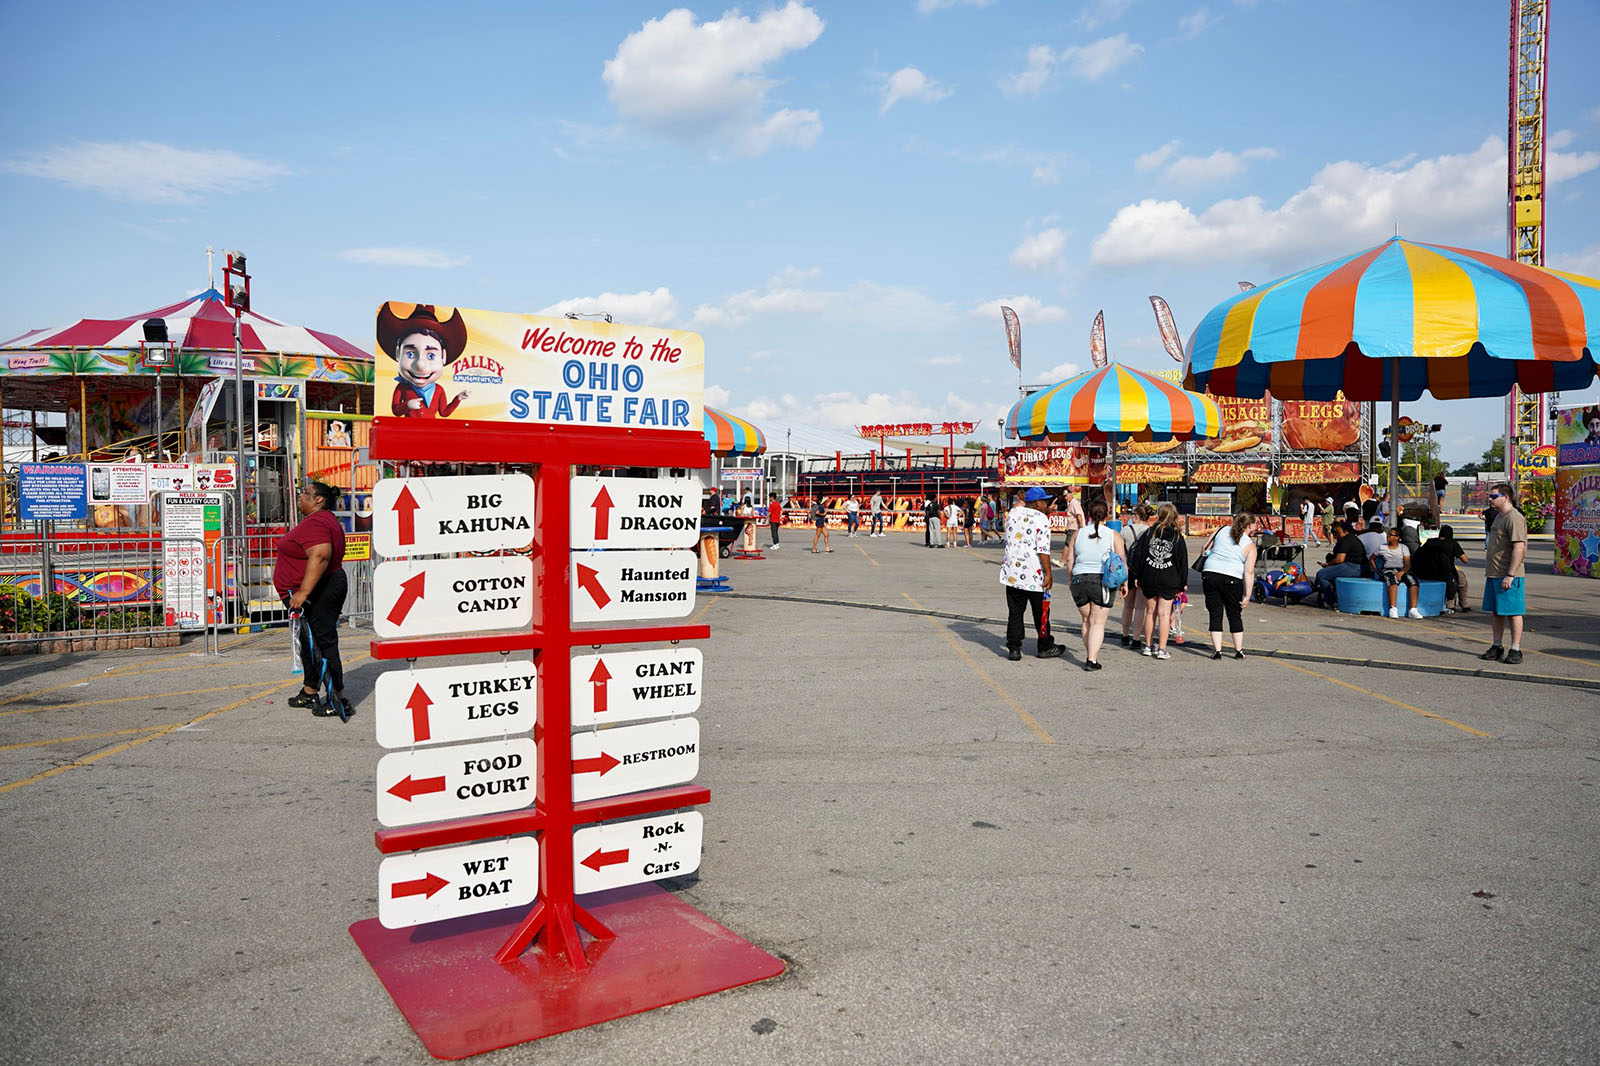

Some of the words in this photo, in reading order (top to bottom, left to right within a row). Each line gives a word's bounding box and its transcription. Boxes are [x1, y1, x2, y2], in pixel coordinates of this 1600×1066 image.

[521, 327, 616, 357] Welcome
[622, 336, 643, 359] to
[649, 337, 682, 363] the
[452, 355, 505, 377] TALLEY
[562, 359, 644, 393] OHIO
[510, 388, 612, 423] STATE
[623, 397, 690, 427] FAIR
[1299, 404, 1344, 418] LEGS
[861, 423, 932, 438] MONSTER
[1016, 449, 1049, 463] TURKEY
[1051, 447, 1072, 460] LEGS
[1517, 455, 1549, 468] MEGA
[1561, 447, 1600, 463] RELOAD
[22, 465, 84, 475] WARNING:
[1198, 463, 1244, 472] ITALIAN
[1281, 462, 1334, 471] TURKEY
[1290, 470, 1325, 478] LEGS
[157, 480, 170, 488] 014
[213, 469, 234, 483] 5
[1571, 474, 1600, 501] TALLE
[467, 493, 503, 510] BIG
[638, 494, 683, 509] IRON
[438, 515, 531, 535] KAHUNA
[620, 516, 697, 532] DRAGON
[1145, 556, 1173, 569] FREEDOM
[621, 567, 690, 582] Haunted
[452, 575, 526, 593] COTTON
[457, 596, 521, 614] CANDY
[620, 590, 687, 604] Mansion
[635, 660, 695, 678] GIANT
[448, 675, 536, 698] TURKEY
[632, 683, 697, 701] WHEEL
[467, 701, 519, 721] LEGS
[622, 743, 696, 766] RESTROOM
[463, 753, 523, 776] FOOD
[456, 776, 530, 800] COURT
[643, 820, 685, 840] Rock
[653, 841, 673, 855] -N-
[462, 856, 509, 877] WET
[643, 860, 681, 877] Cars
[458, 878, 513, 901] BOAT
